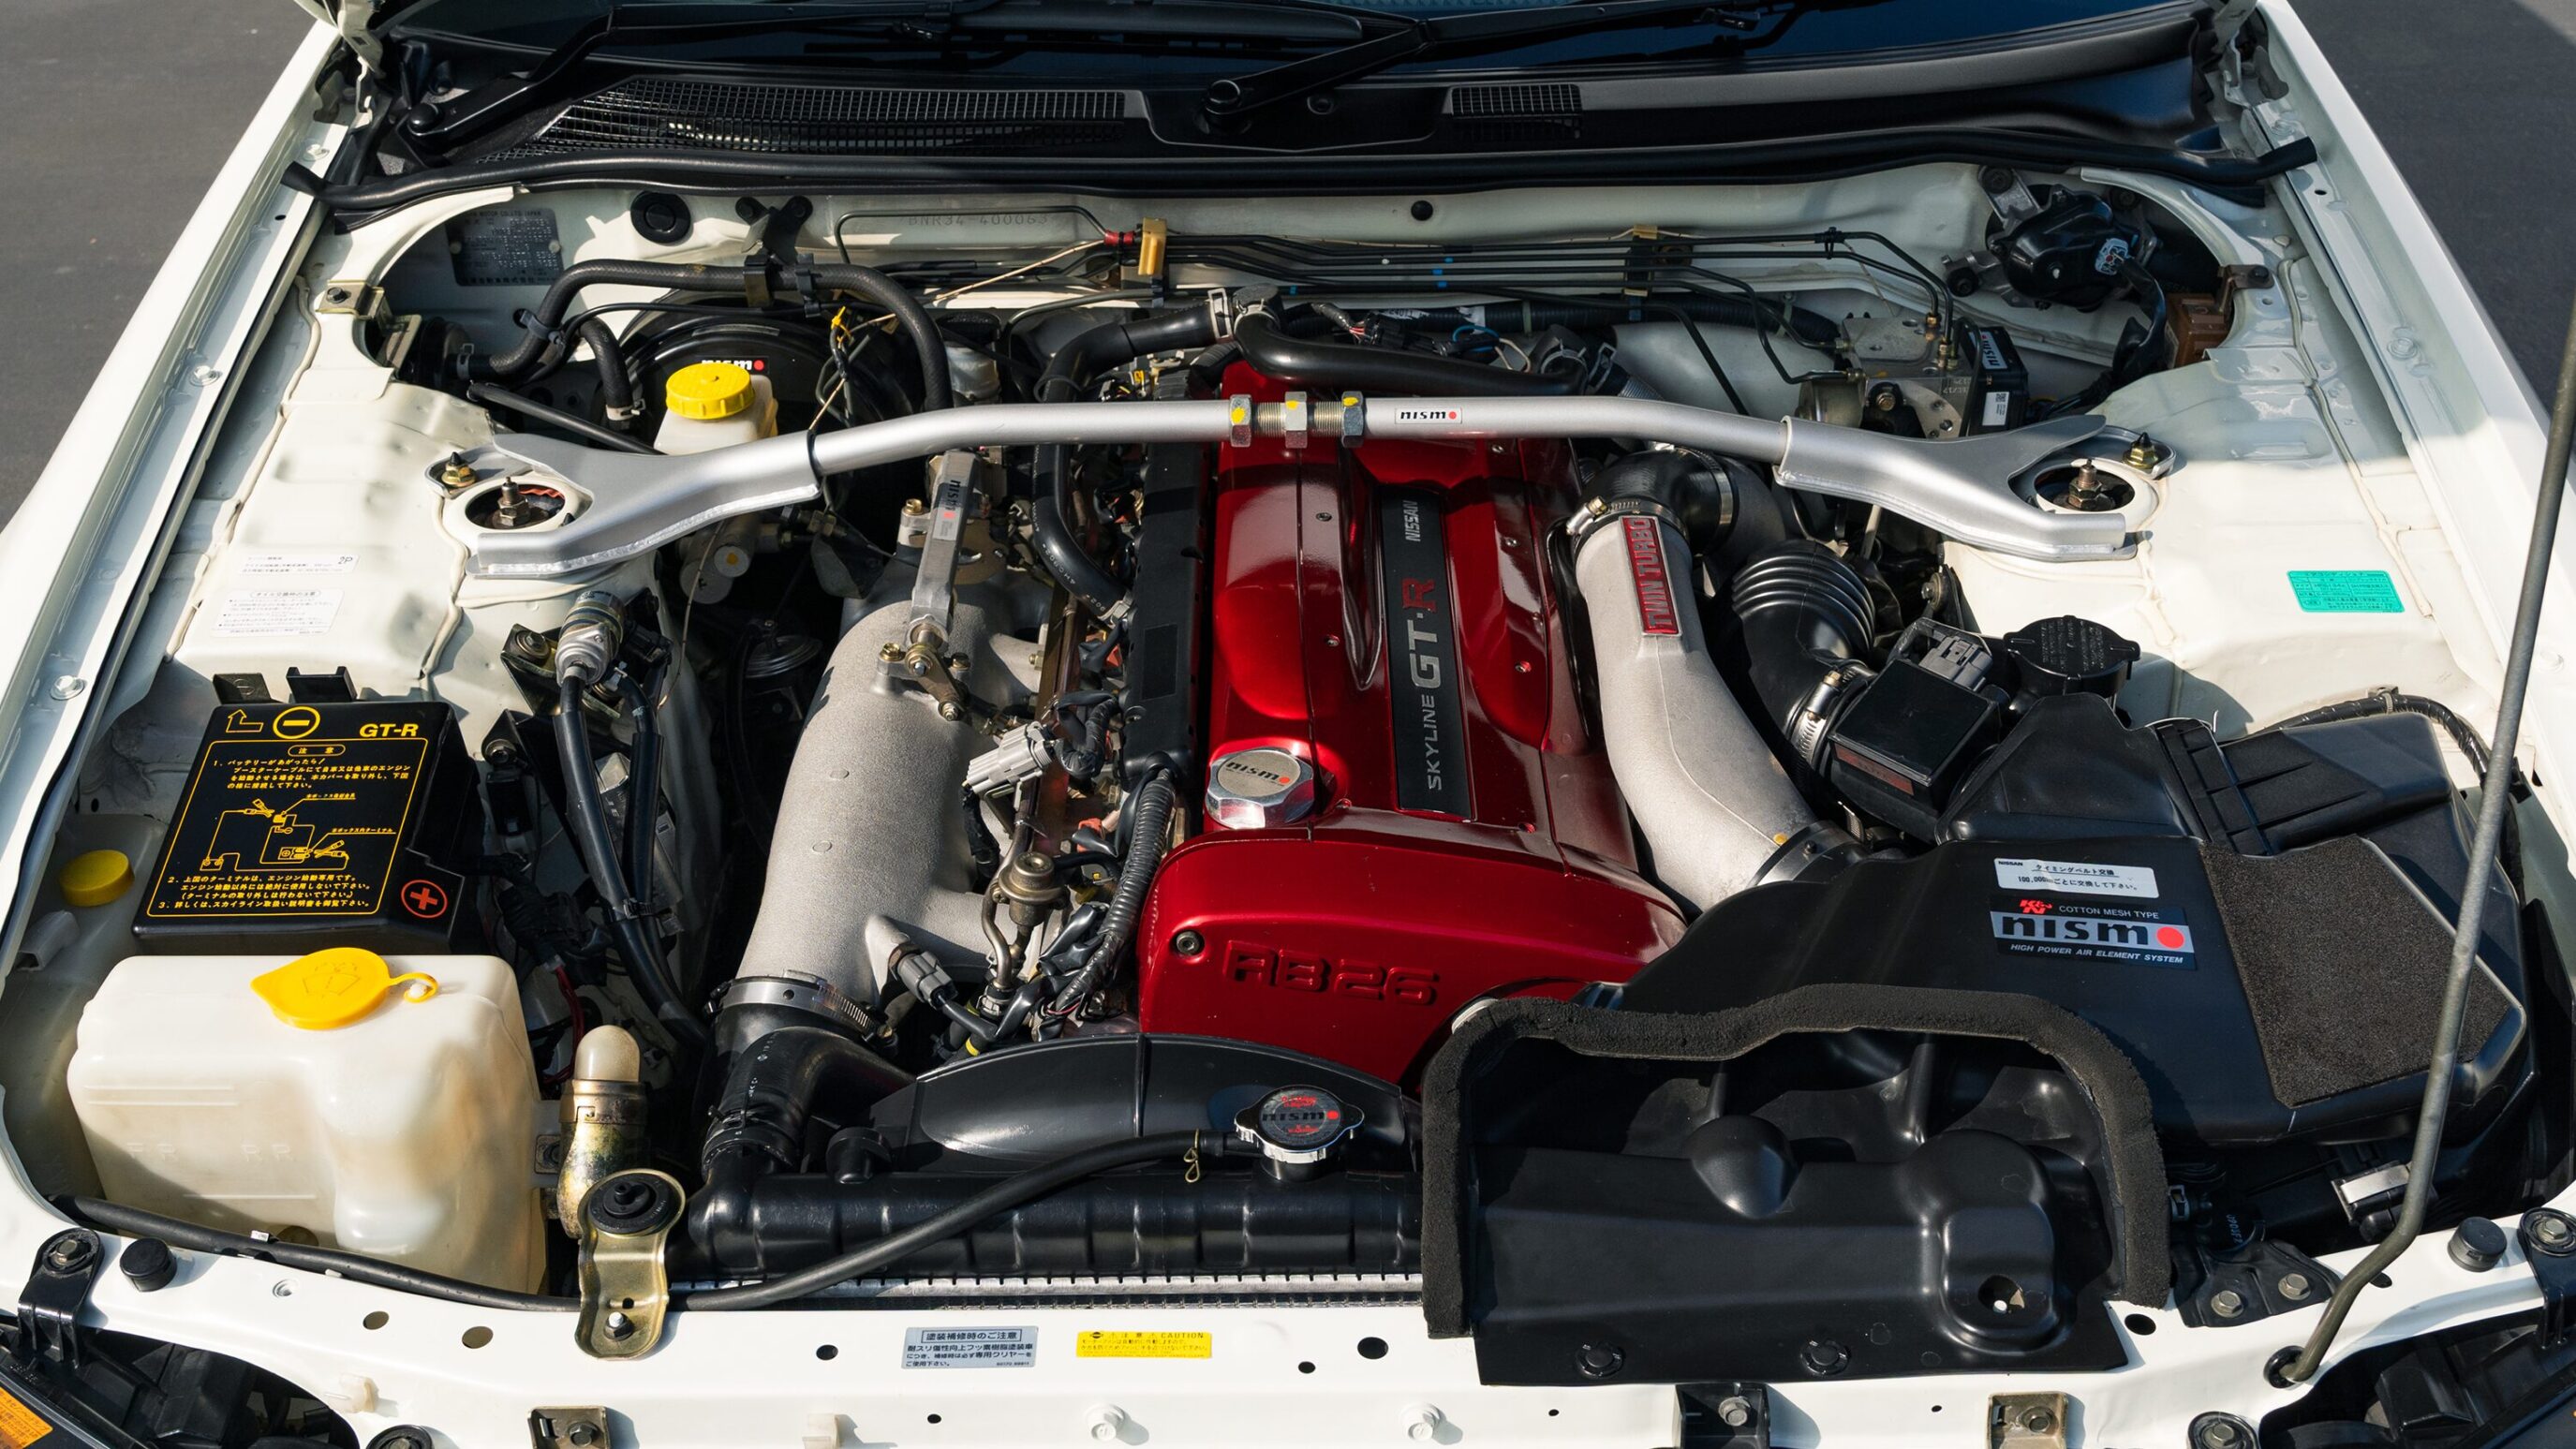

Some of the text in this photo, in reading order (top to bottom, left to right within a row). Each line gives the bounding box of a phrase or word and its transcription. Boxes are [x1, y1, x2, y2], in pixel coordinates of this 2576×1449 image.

[1402, 500, 1421, 542] NISSAN
[1630, 518, 1673, 628] TWIN TURBO
[359, 723, 420, 738] GT-R
[1421, 694, 1443, 791] SKYLINE
[2058, 905, 2101, 916] COTTON
[2103, 908, 2132, 918] MESH
[2133, 910, 2160, 920] TYPE
[1222, 930, 1441, 1006] RB26
[2010, 943, 2184, 964] HIGH POWER AIR ELEMENT SYSTEM
[925, 1331, 1018, 1341] 塗装補修時のご注意
